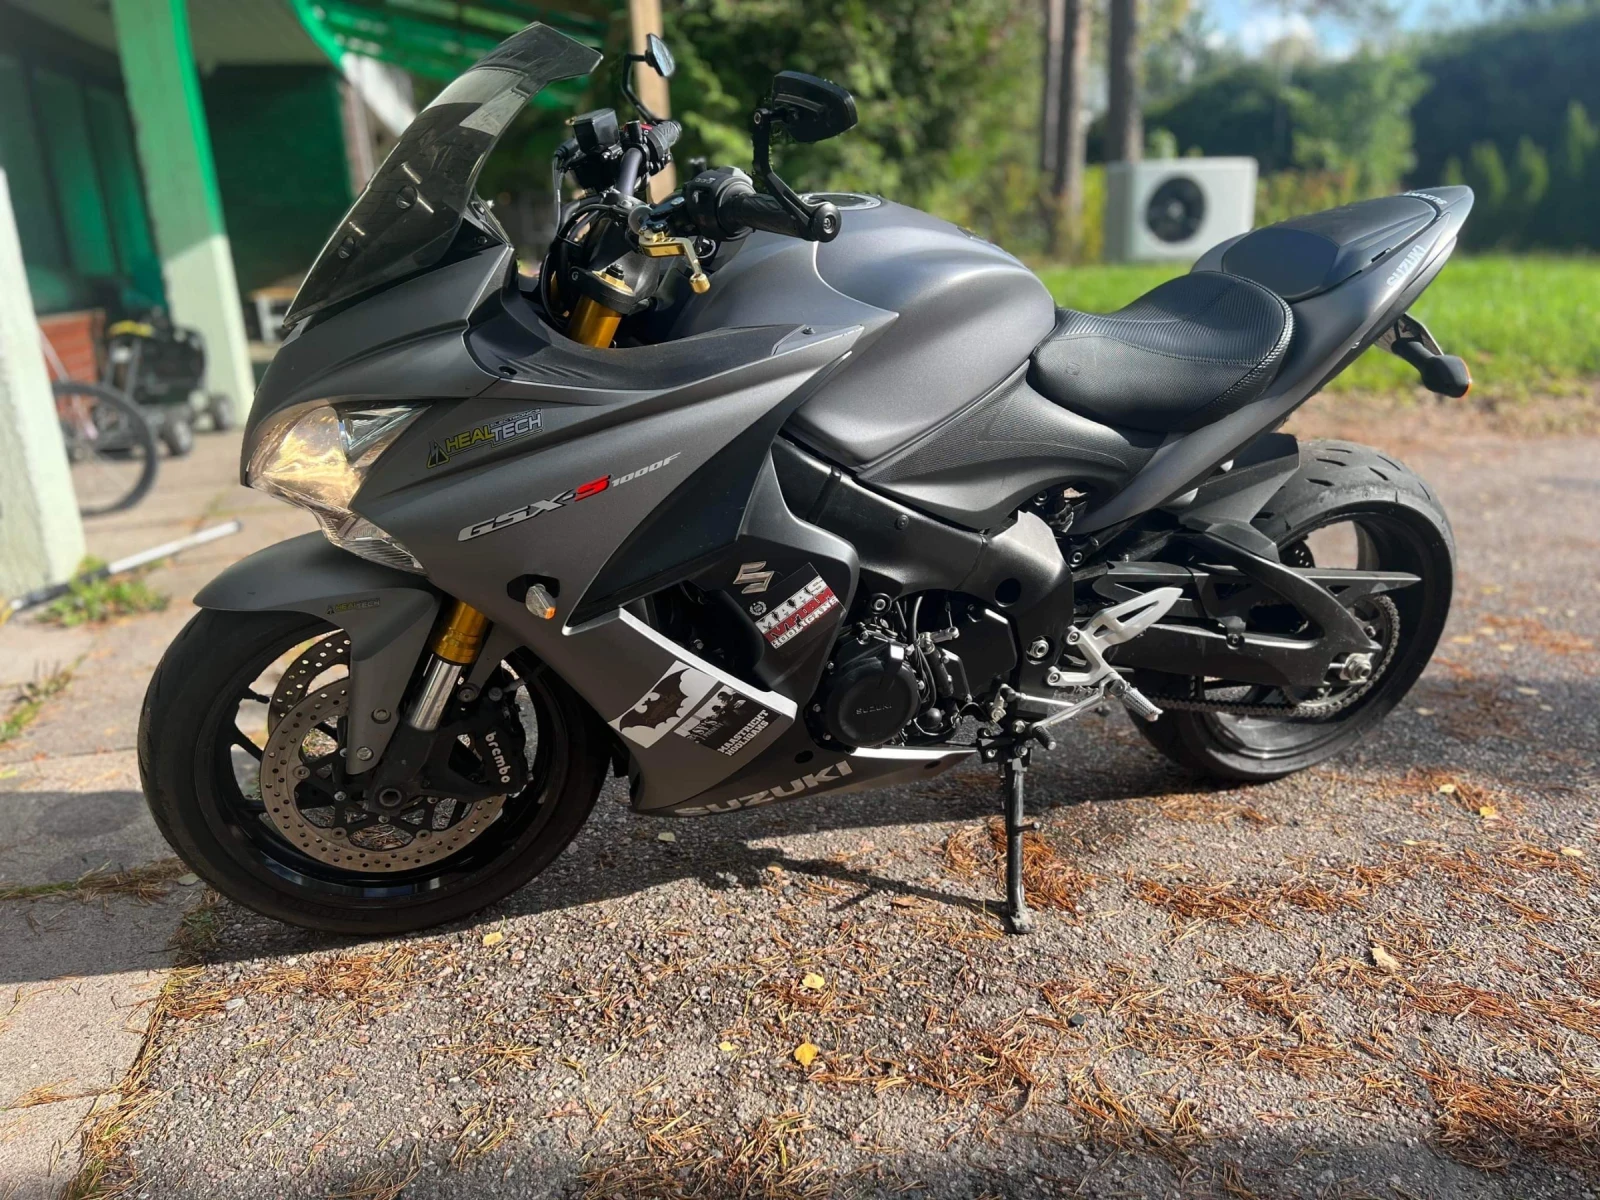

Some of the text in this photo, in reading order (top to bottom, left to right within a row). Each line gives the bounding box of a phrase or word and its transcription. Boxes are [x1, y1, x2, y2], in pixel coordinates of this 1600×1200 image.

[1386, 244, 1427, 287] SUZUKI
[445, 414, 542, 452] HEALTECH
[755, 575, 828, 634] MAAS
[770, 595, 839, 649] HOOLIGANS
[717, 709, 769, 753] MAASTRICHT
[856, 704, 892, 715] SUZUKI
[485, 731, 511, 784] brembo
[725, 720, 769, 756] HOOLIGANS
[674, 760, 852, 817] SUZUKI
